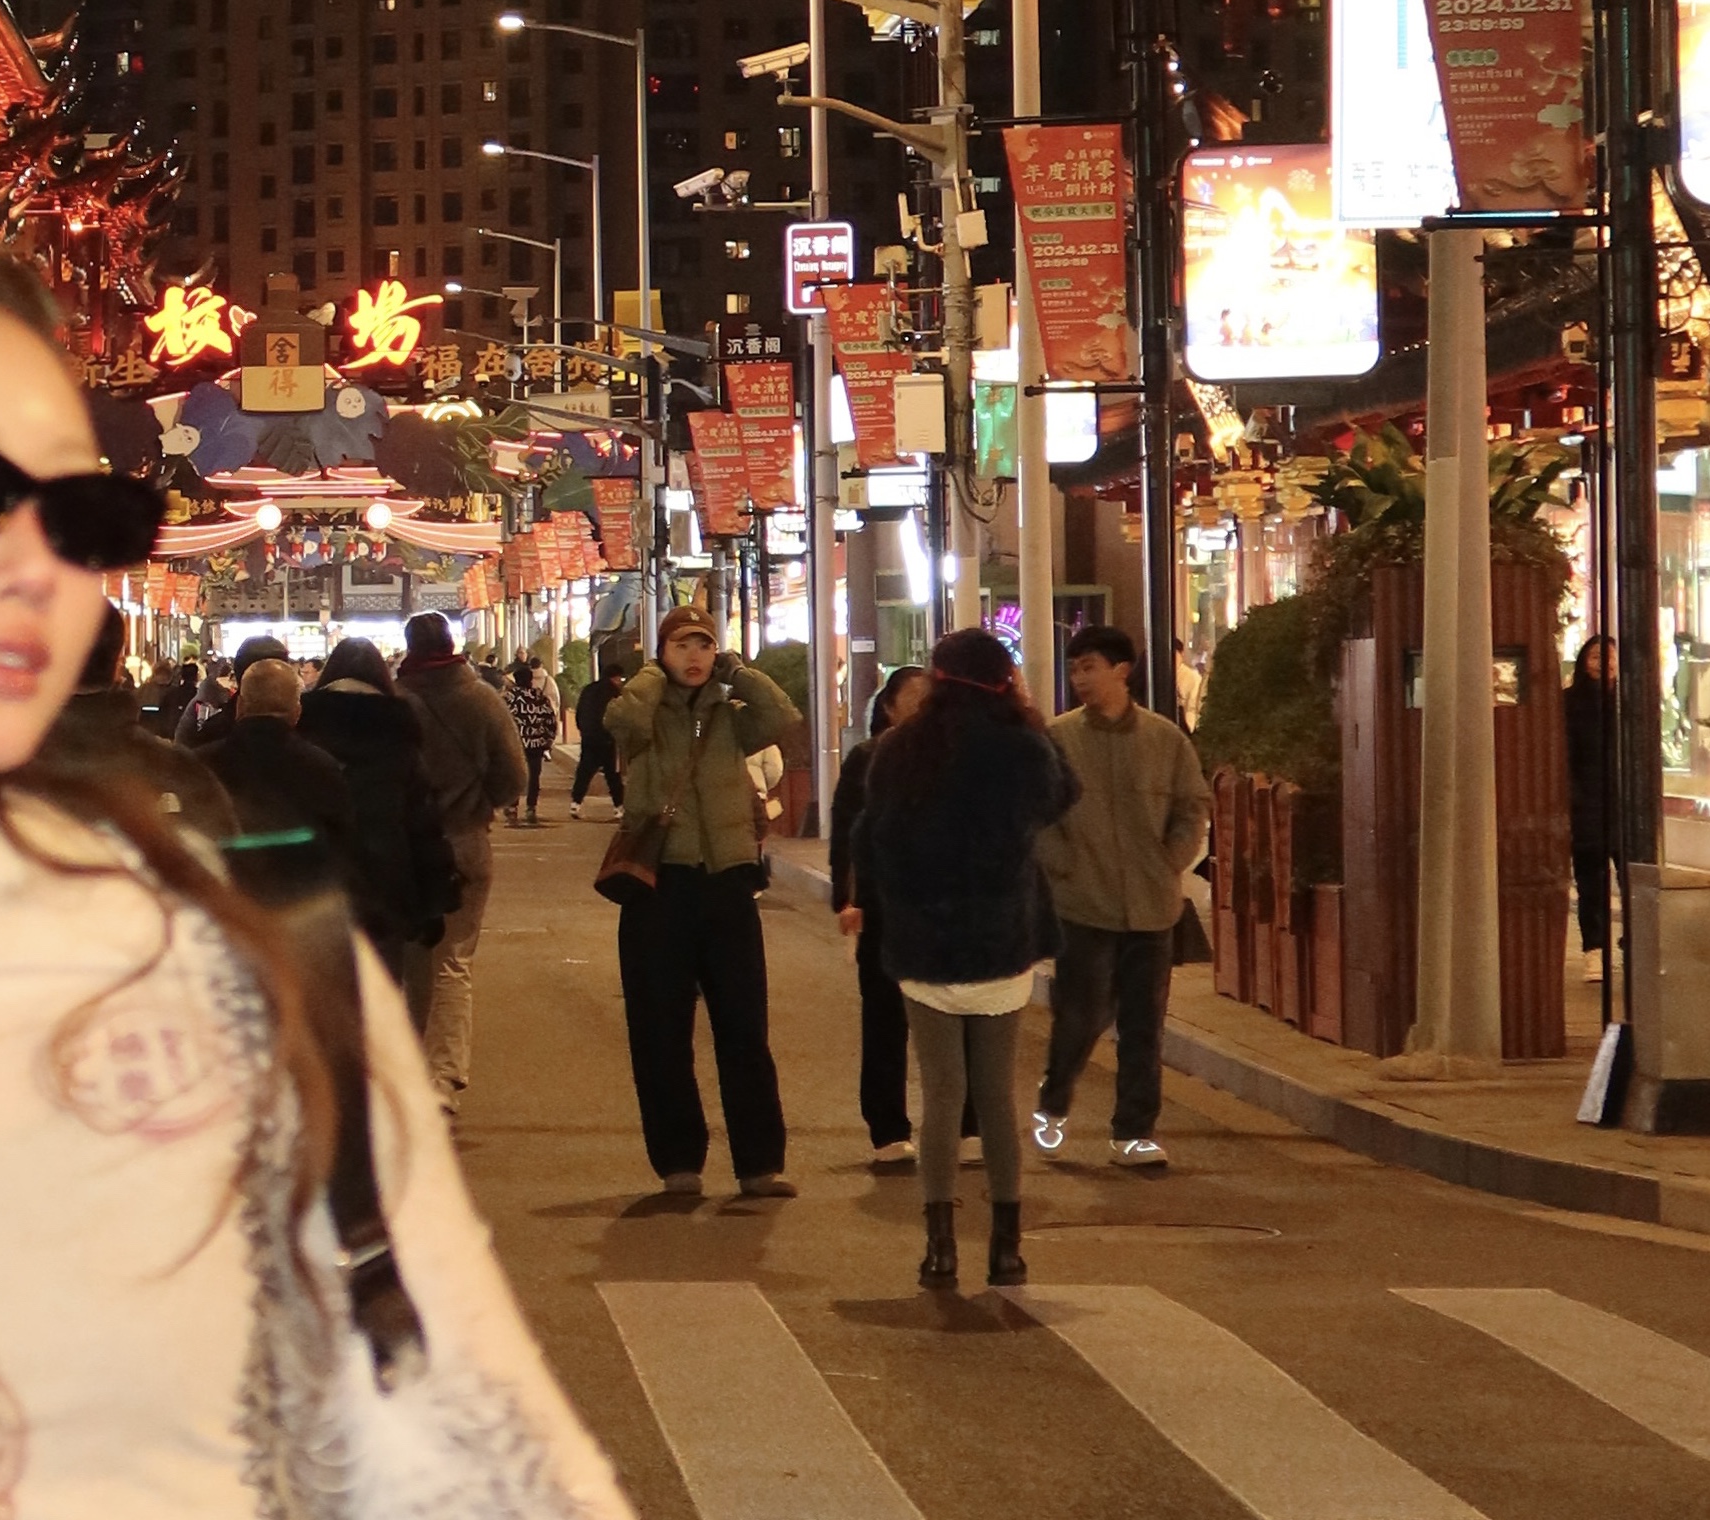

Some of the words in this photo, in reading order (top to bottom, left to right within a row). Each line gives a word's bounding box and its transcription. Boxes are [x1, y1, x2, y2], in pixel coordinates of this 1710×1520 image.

[1439, 17, 1526, 33] 23:59:59
[1021, 160, 1116, 182] 年度清零
[792, 235, 849, 256] 沉香阁
[1033, 243, 1120, 258] 2024.12.31
[726, 336, 781, 355] 沉香阁
